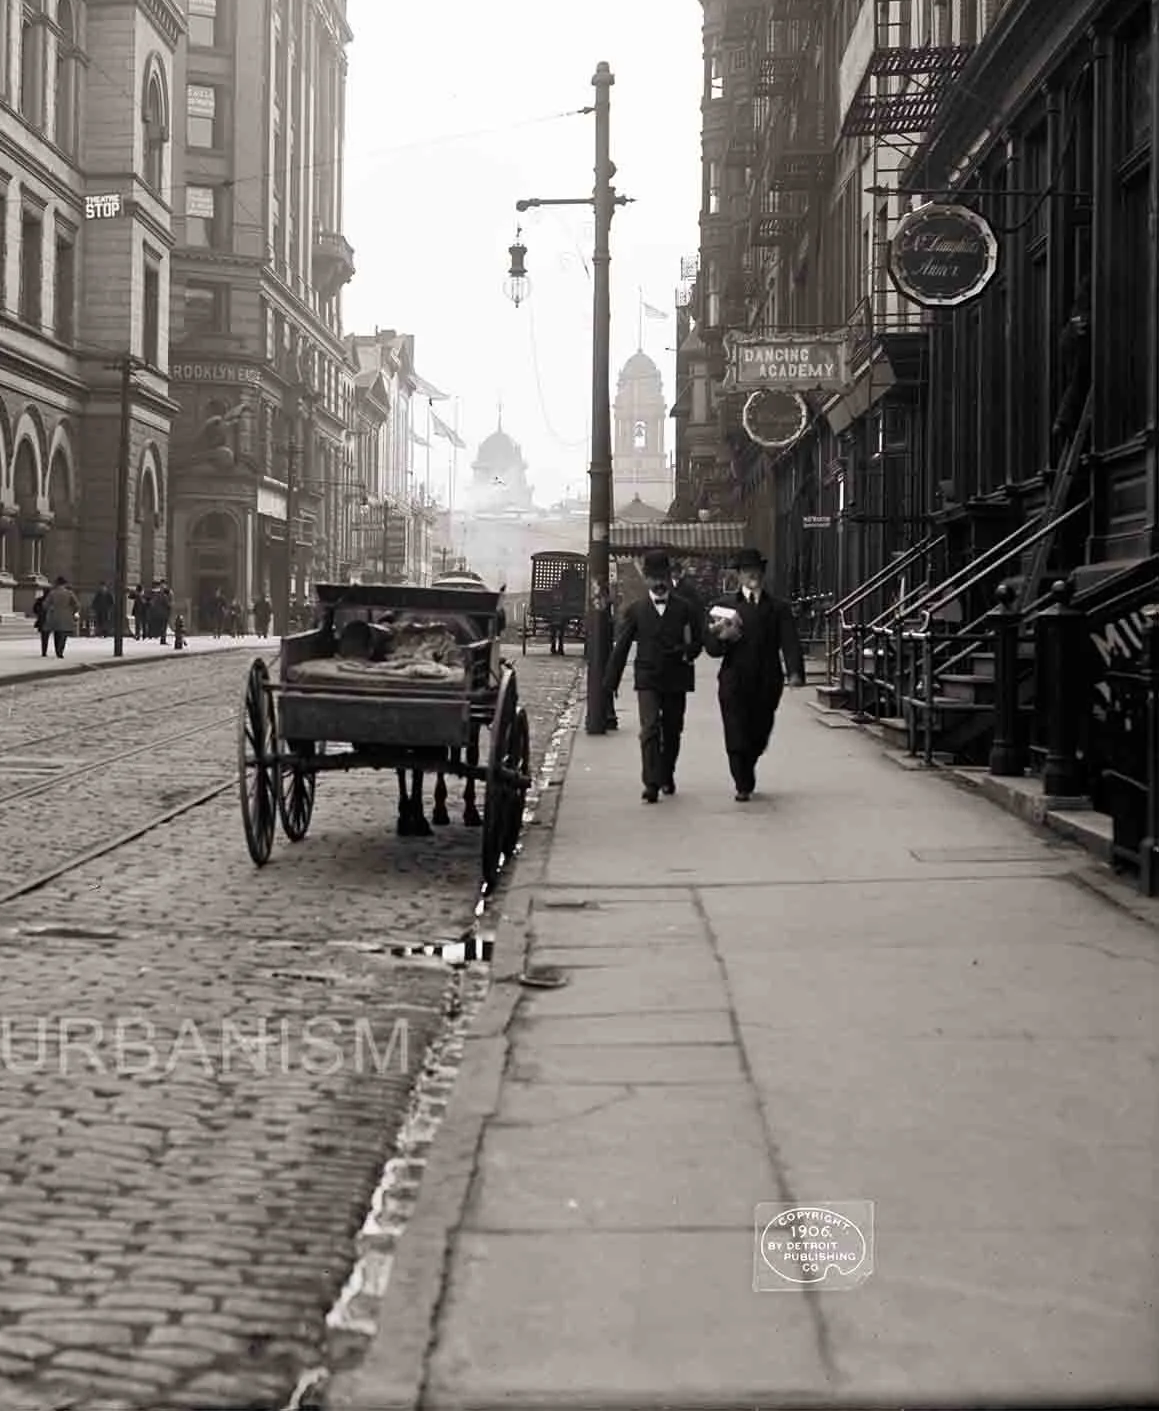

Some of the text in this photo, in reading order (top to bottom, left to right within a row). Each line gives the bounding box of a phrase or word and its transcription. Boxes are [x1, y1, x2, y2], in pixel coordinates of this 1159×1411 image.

[86, 202, 120, 218] STOP
[744, 347, 809, 363] DANCING
[168, 364, 236, 381] ROOKLYN
[759, 363, 834, 377] ACADEMY
